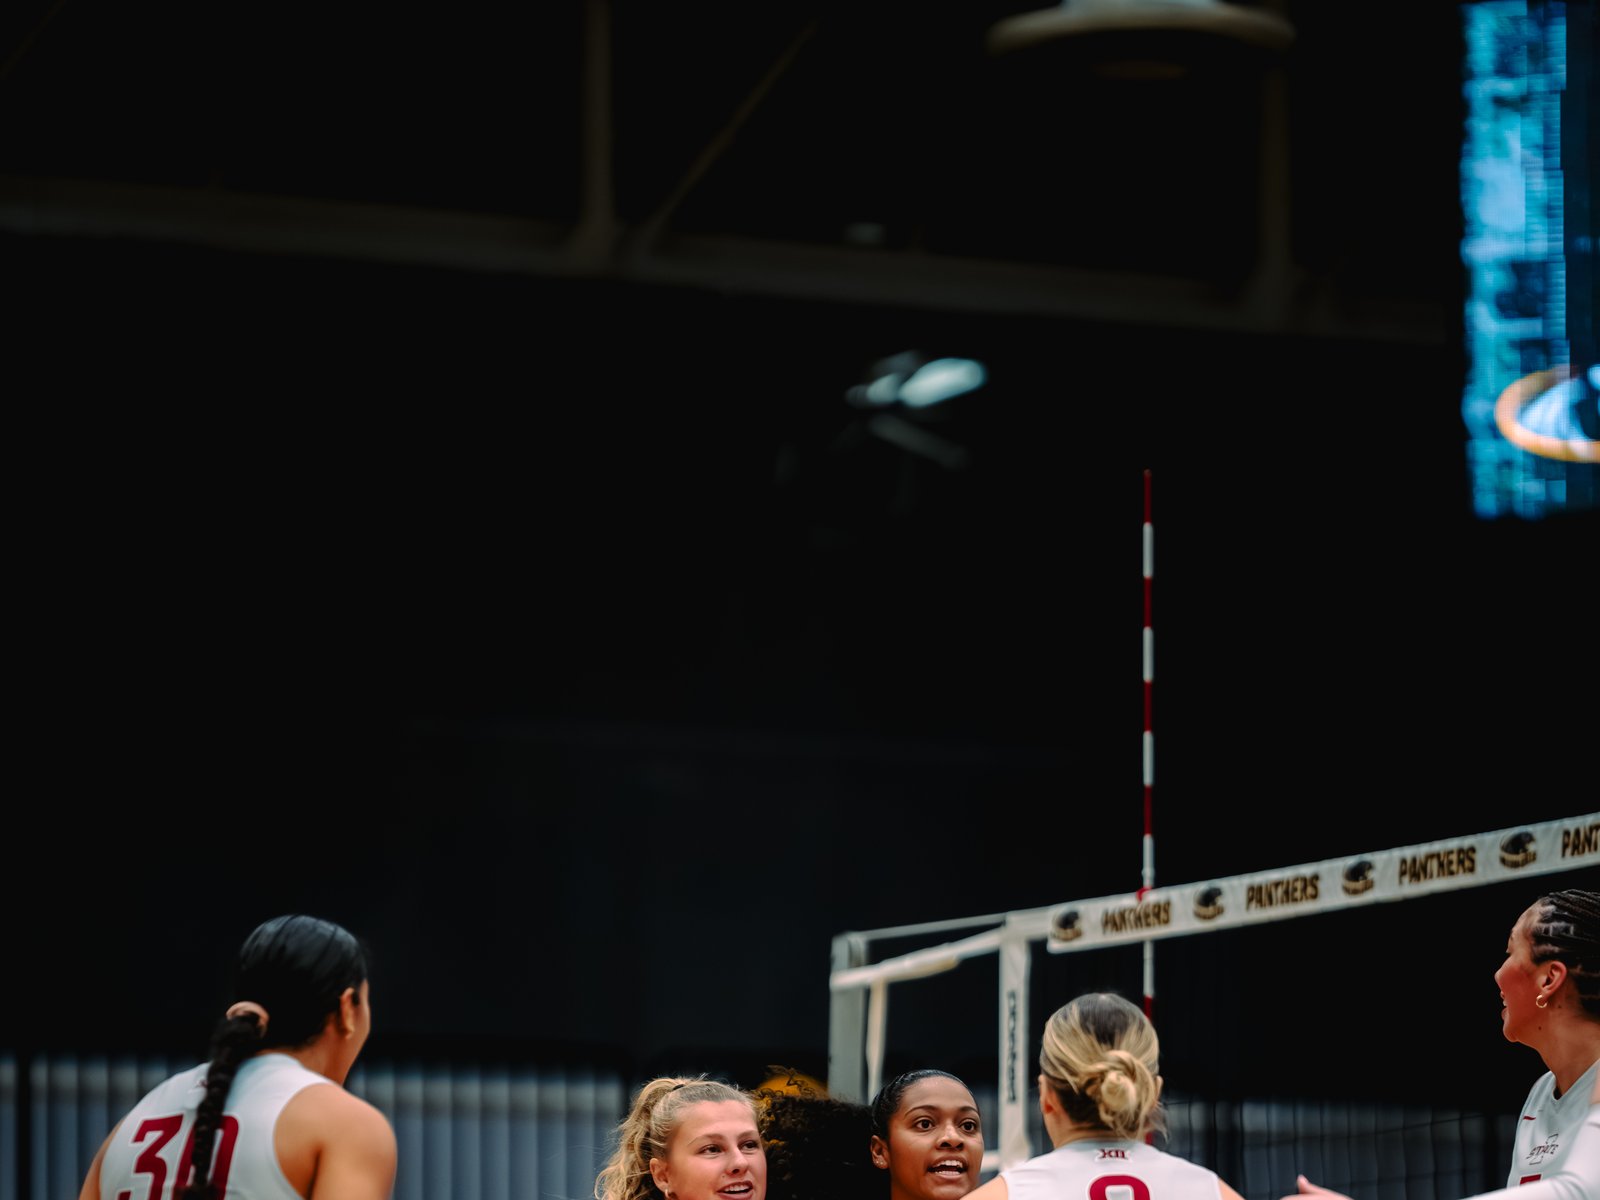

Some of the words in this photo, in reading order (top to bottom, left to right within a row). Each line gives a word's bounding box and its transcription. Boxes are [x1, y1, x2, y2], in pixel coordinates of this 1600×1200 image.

[1101, 901, 1171, 935] PANTHERS
[1246, 874, 1320, 910] PANTHERS
[1399, 846, 1477, 885] PANTHERS
